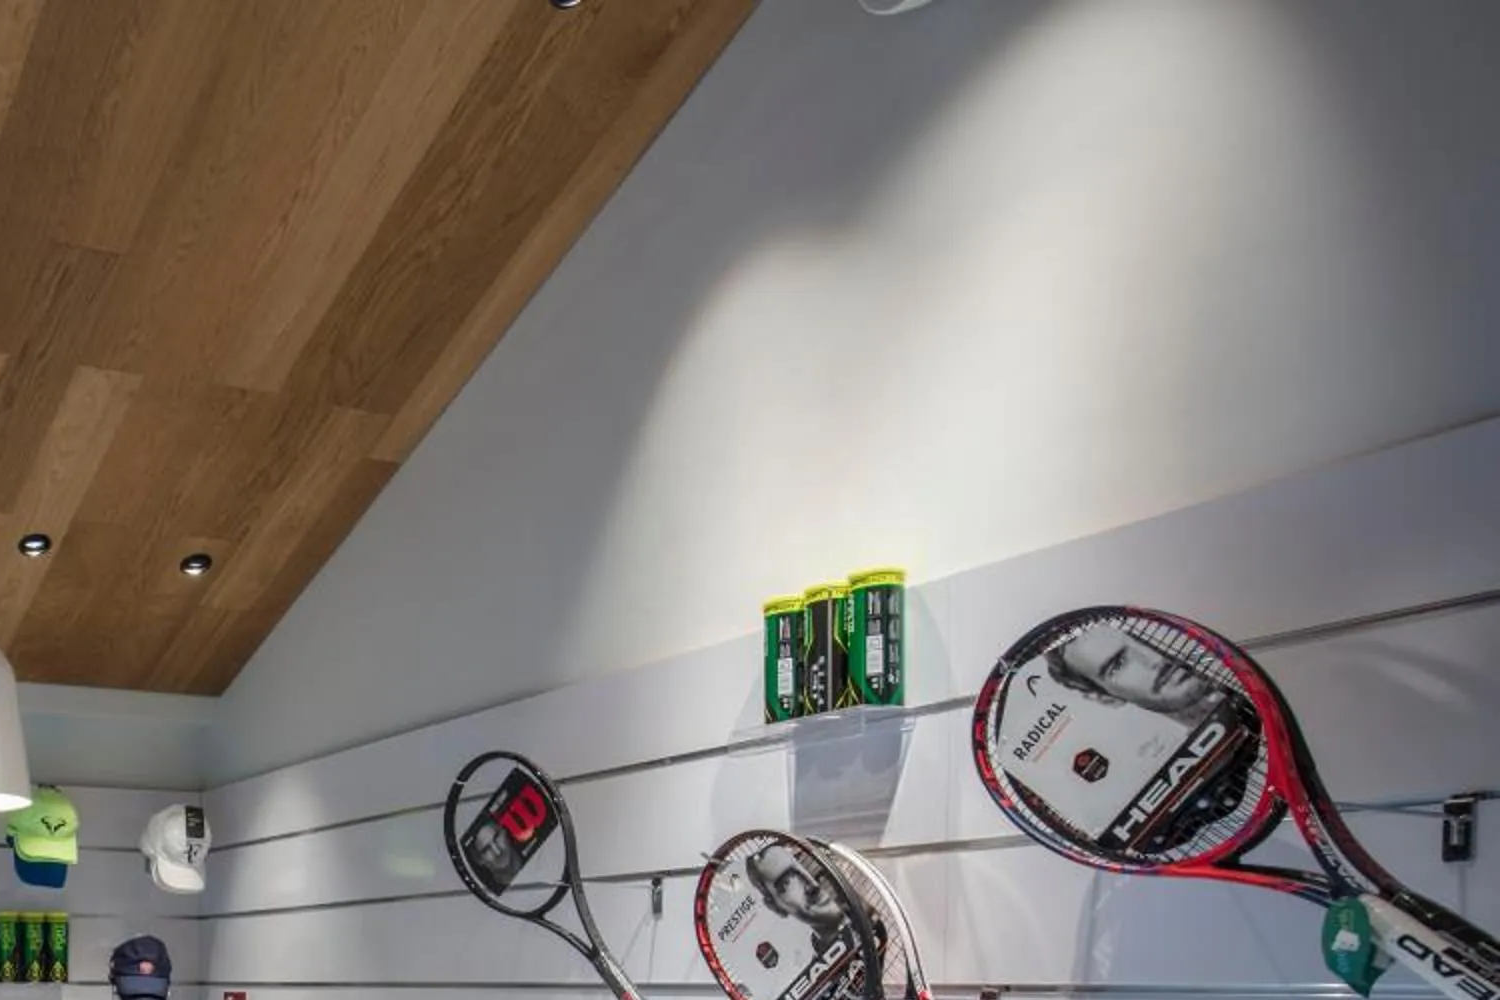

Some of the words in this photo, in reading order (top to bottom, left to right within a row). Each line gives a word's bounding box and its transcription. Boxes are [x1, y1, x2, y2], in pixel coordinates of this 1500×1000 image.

[1012, 701, 1067, 762] RADICAL
[1112, 721, 1227, 843] HEAD
[717, 895, 756, 942] PRESTIGE
